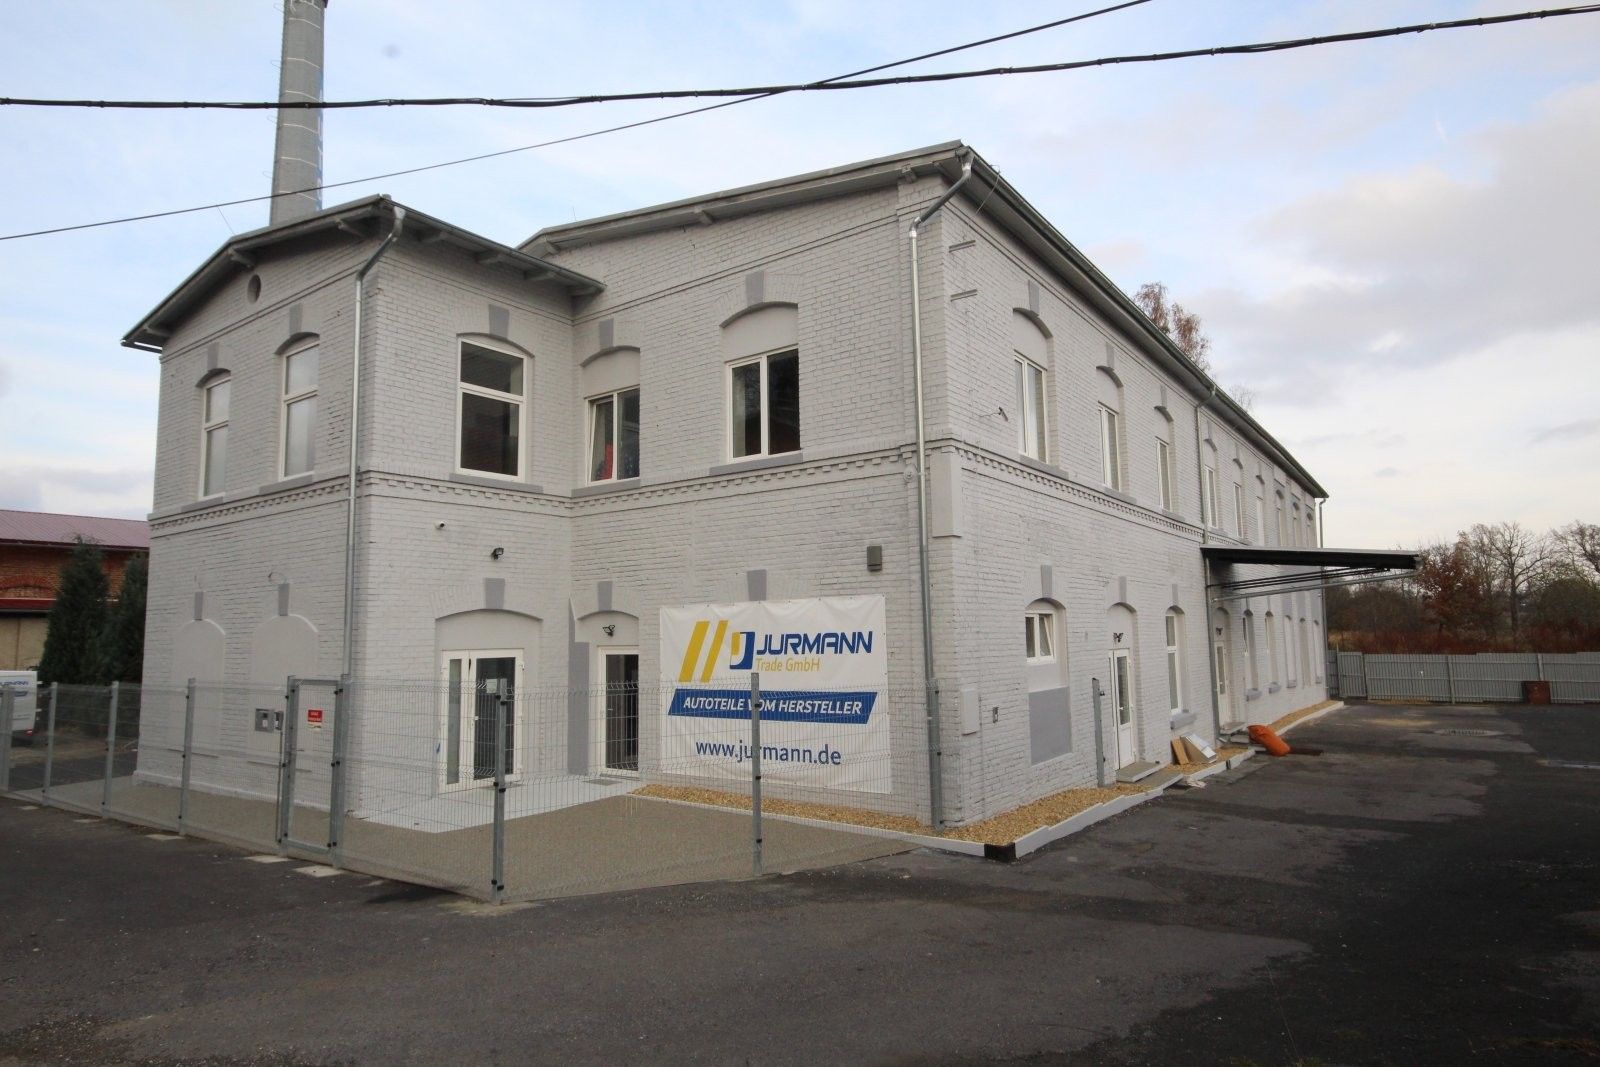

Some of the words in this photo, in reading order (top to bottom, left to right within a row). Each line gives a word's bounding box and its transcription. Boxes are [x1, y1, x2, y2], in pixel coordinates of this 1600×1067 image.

[756, 631, 873, 655] JURMANN
[756, 658, 782, 672] Trade
[786, 657, 820, 672] GmbH
[683, 697, 745, 710] AUTOTEILE
[779, 701, 862, 714] HERSTELLER
[695, 740, 842, 766] www.jumann.de
